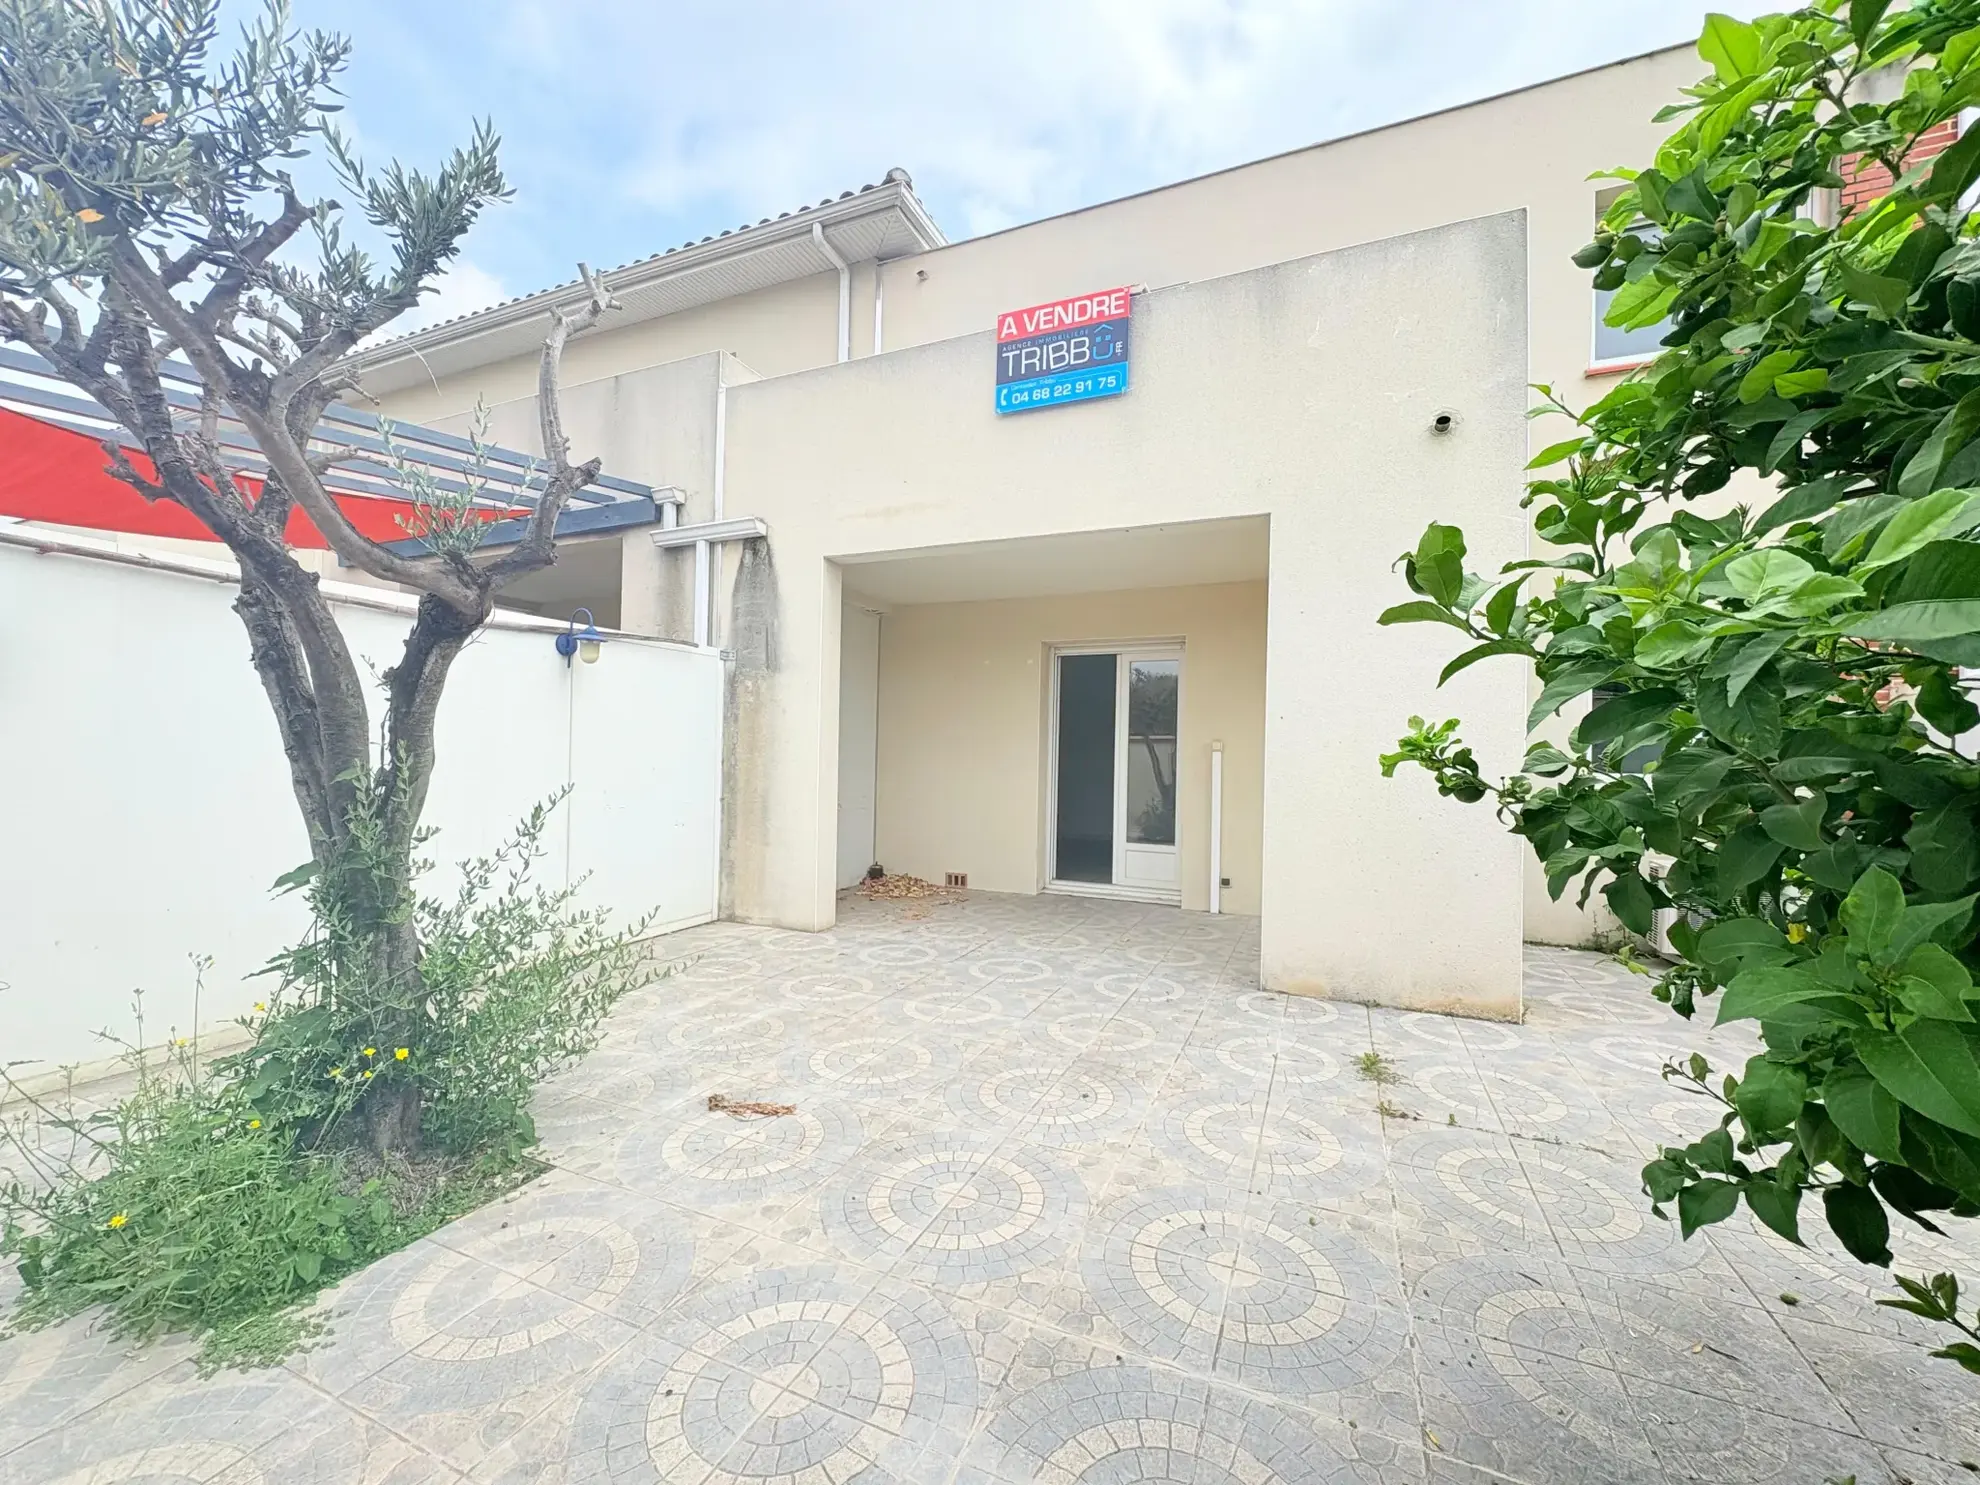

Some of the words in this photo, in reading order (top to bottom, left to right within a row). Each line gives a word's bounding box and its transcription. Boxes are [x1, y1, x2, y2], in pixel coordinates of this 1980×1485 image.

[1000, 316, 1018, 338] A
[1023, 291, 1126, 332] VENDRE
[1002, 341, 1032, 352] AGENCE
[1011, 390, 1029, 404] 04
[1032, 386, 1050, 400] 68
[1053, 383, 1072, 397] 22
[1075, 379, 1092, 393] 91
[1097, 375, 1117, 389] 75
